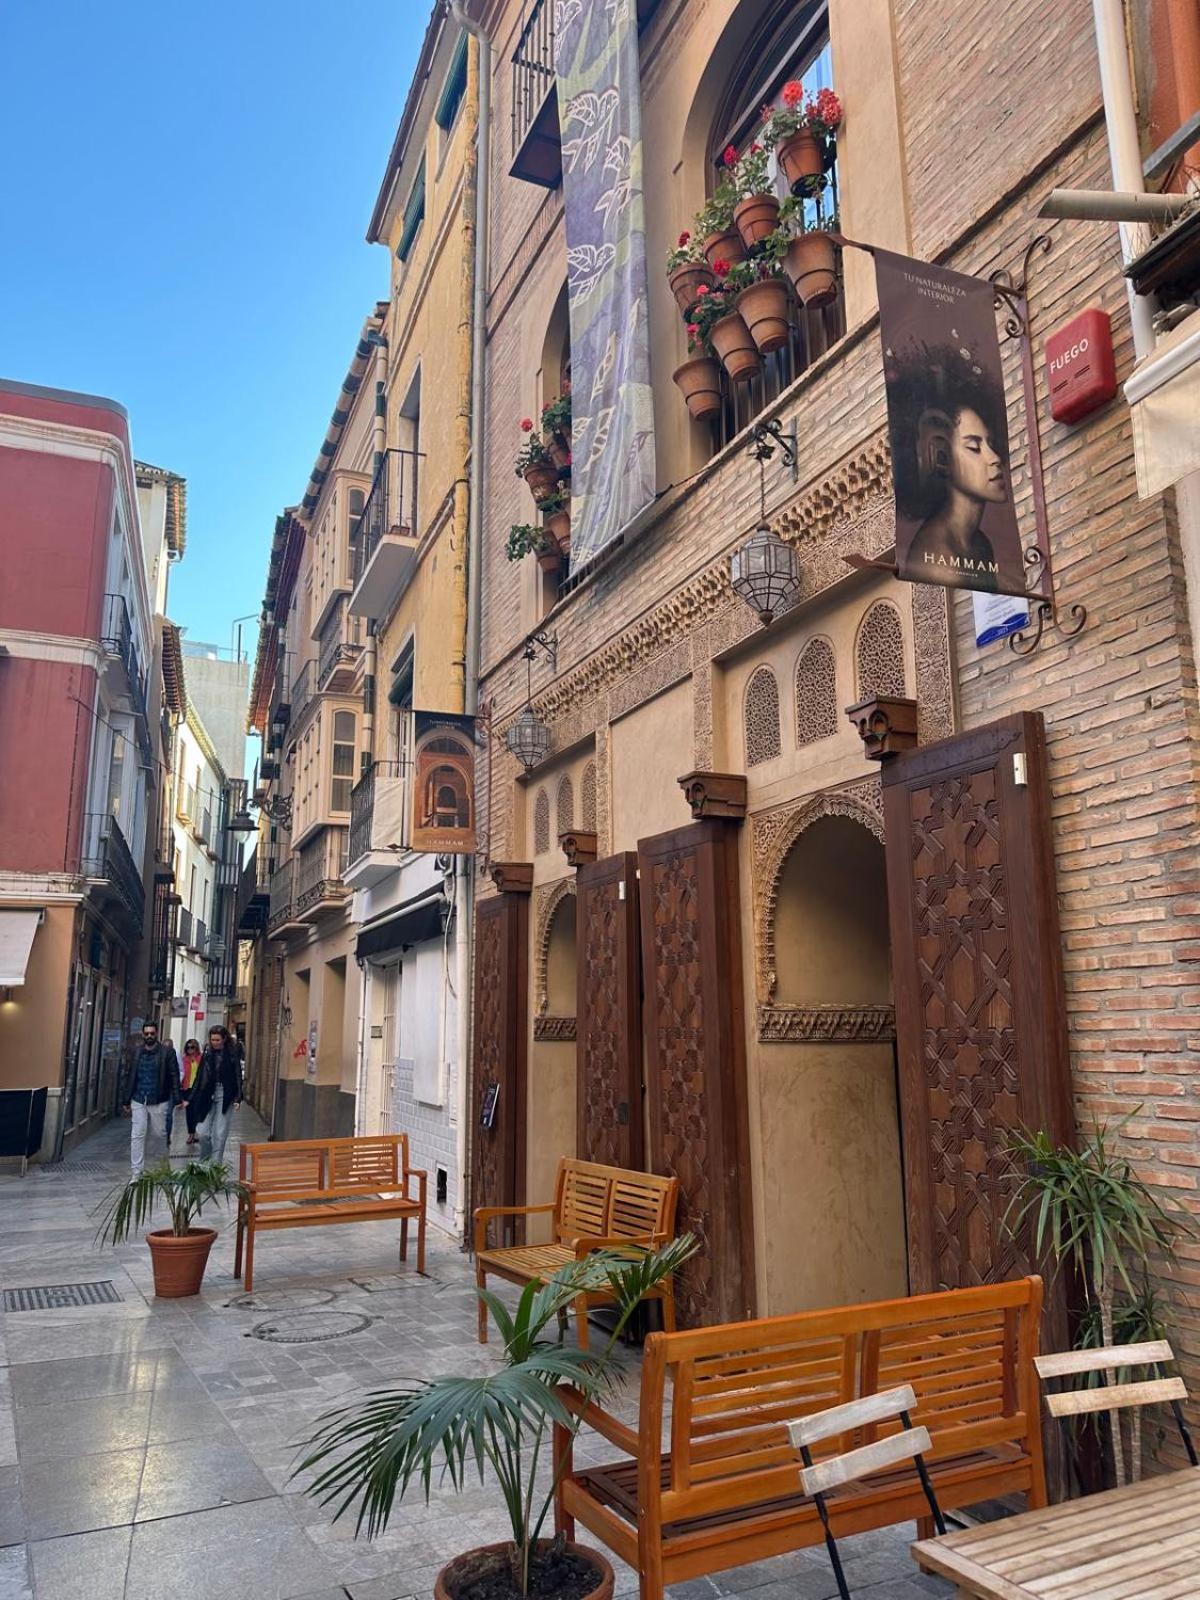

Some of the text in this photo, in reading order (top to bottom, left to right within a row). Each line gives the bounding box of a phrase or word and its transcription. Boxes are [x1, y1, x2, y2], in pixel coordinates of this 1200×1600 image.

[903, 272, 966, 297] TU NATURALEZA
[917, 287, 955, 304] INTERIOR
[1050, 338, 1089, 374] FUEGO
[924, 551, 999, 574] HAMMAM
